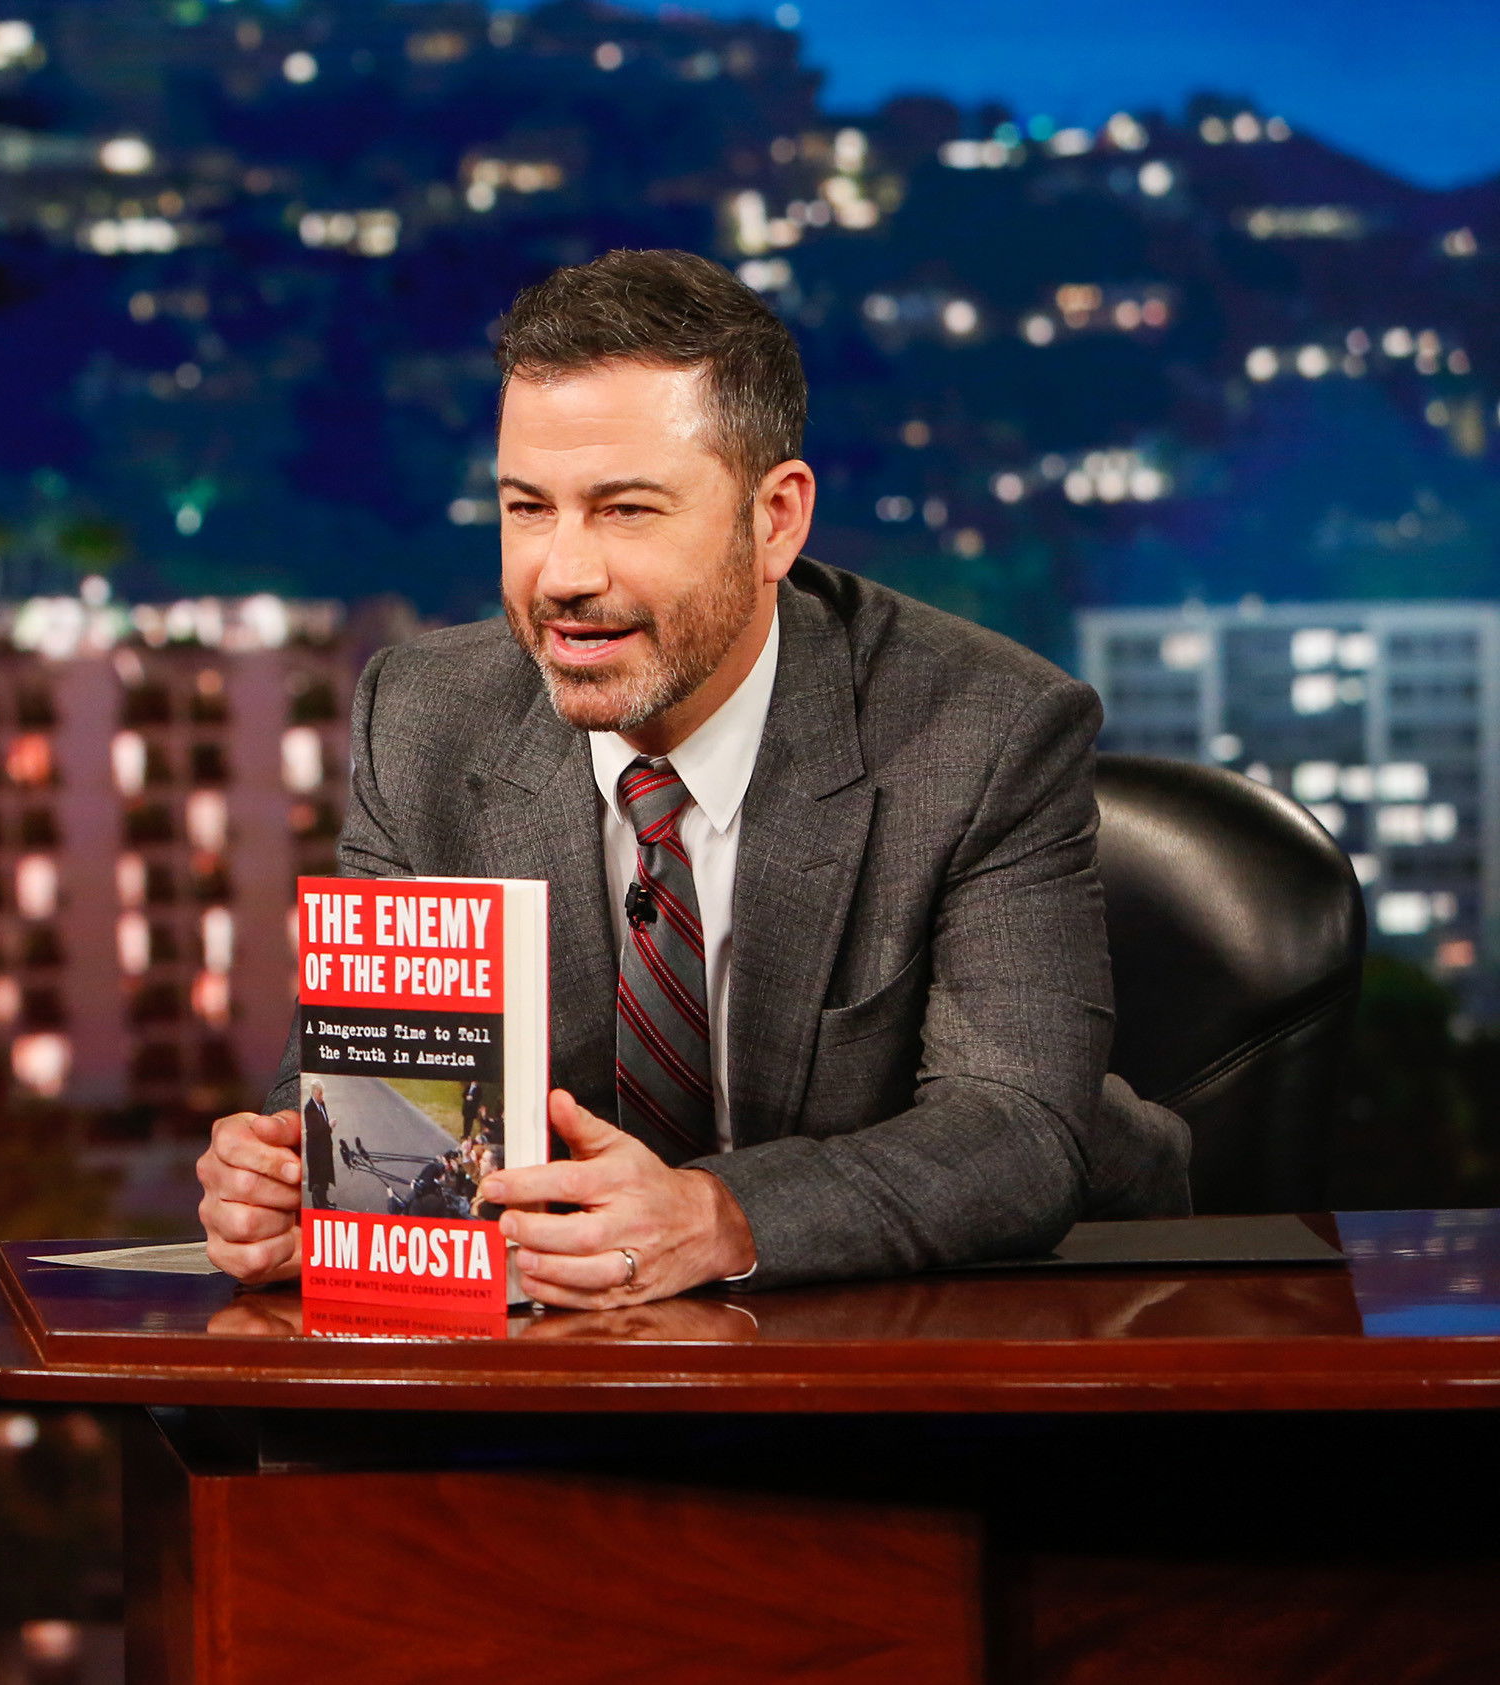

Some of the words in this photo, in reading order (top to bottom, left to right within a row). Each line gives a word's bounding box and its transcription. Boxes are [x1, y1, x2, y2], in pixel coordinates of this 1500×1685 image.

[304, 893, 363, 945] THE
[375, 896, 492, 949] ENEMY
[305, 953, 332, 990] OF
[340, 954, 386, 993] THE
[394, 957, 491, 997] PEOPLE
[306, 1021, 314, 1035] A
[318, 1021, 387, 1040] Dangerous
[394, 1025, 426, 1040] Time
[434, 1027, 450, 1042] to
[458, 1028, 491, 1043] Tell
[319, 1045, 340, 1060] the
[348, 1047, 386, 1063] Truth
[393, 1049, 410, 1064] in
[416, 1051, 475, 1067] America
[310, 1219, 358, 1270] JIM
[369, 1224, 492, 1280] ACOSTA
[309, 1277, 326, 1287] CNN
[329, 1279, 352, 1288] CHIEF
[355, 1280, 379, 1291] WHITE
[382, 1283, 411, 1294] HOUSE
[412, 1285, 492, 1298] CORRESPONDENT
